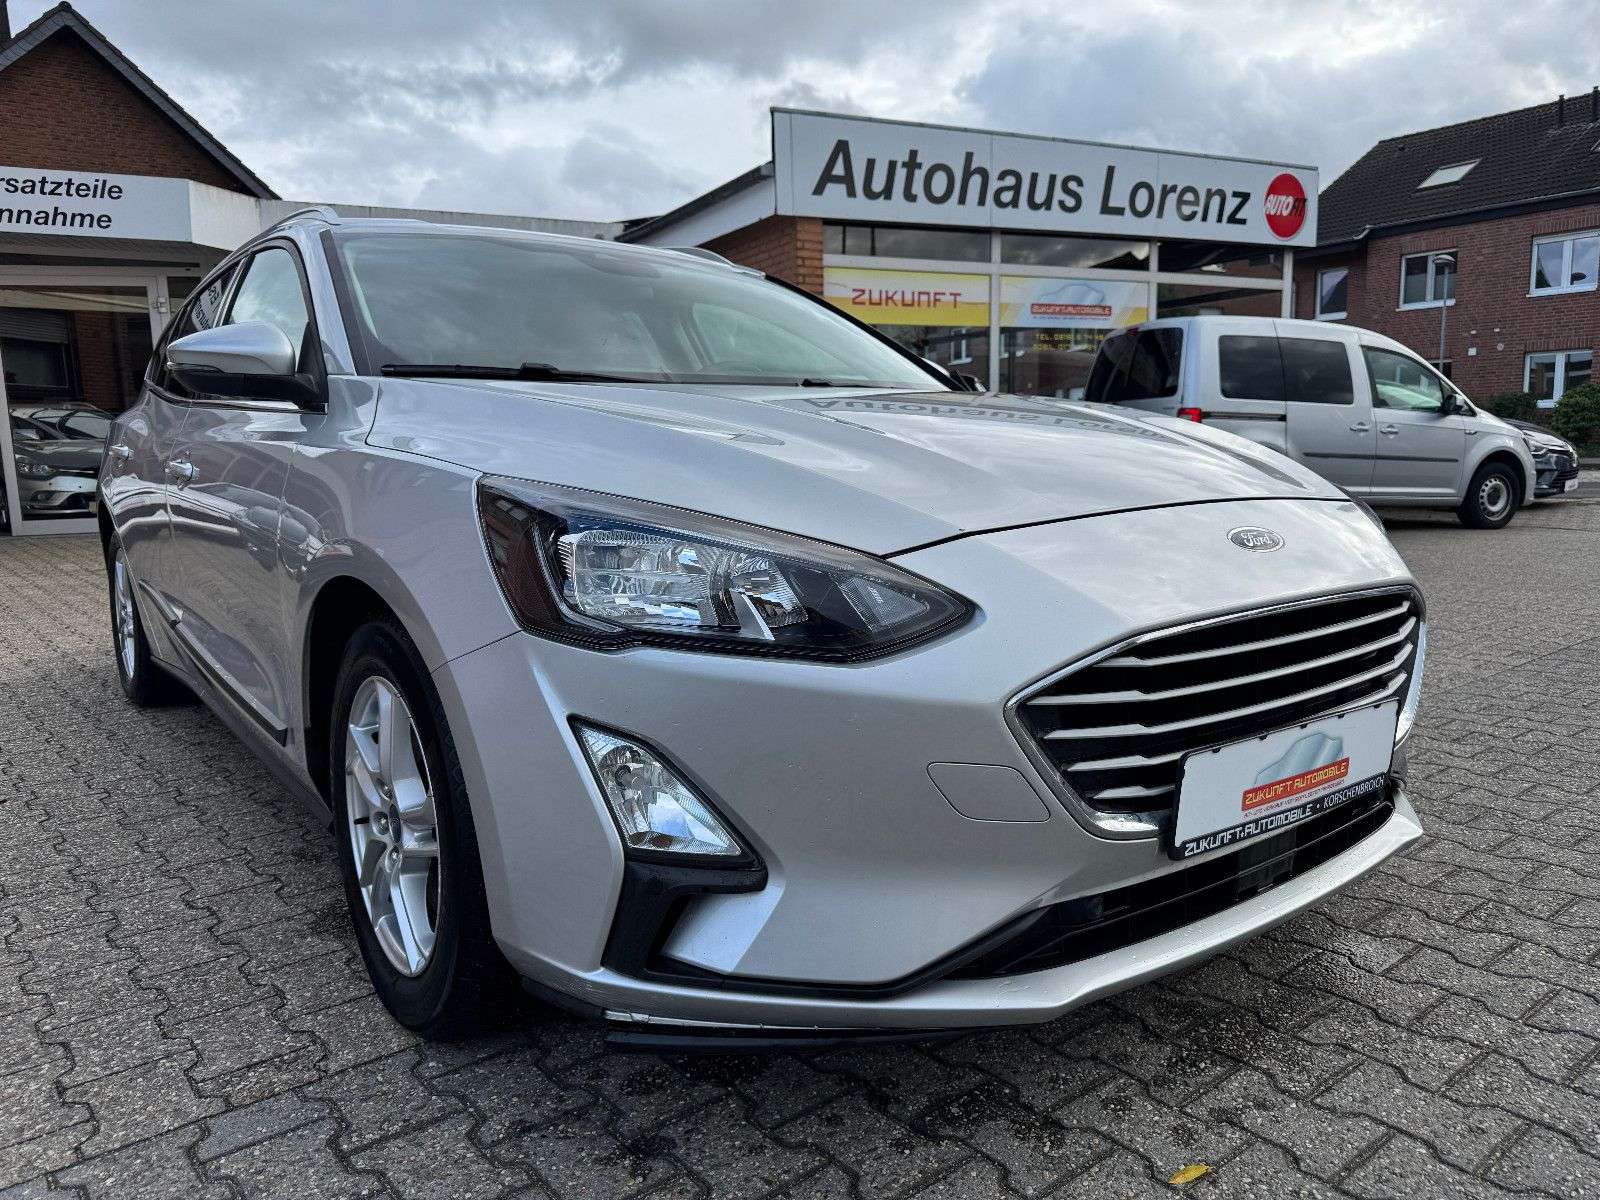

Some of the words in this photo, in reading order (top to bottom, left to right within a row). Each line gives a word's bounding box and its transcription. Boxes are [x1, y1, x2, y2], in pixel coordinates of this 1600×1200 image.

[812, 139, 1084, 214] Autohaus
[1100, 165, 1251, 225] Lorenz
[852, 288, 962, 308] ZUKUNFT
[1241, 532, 1273, 546] Ford
[1245, 781, 1293, 804] ZUKUNFT
[1294, 762, 1346, 788] AUTOMOBILE
